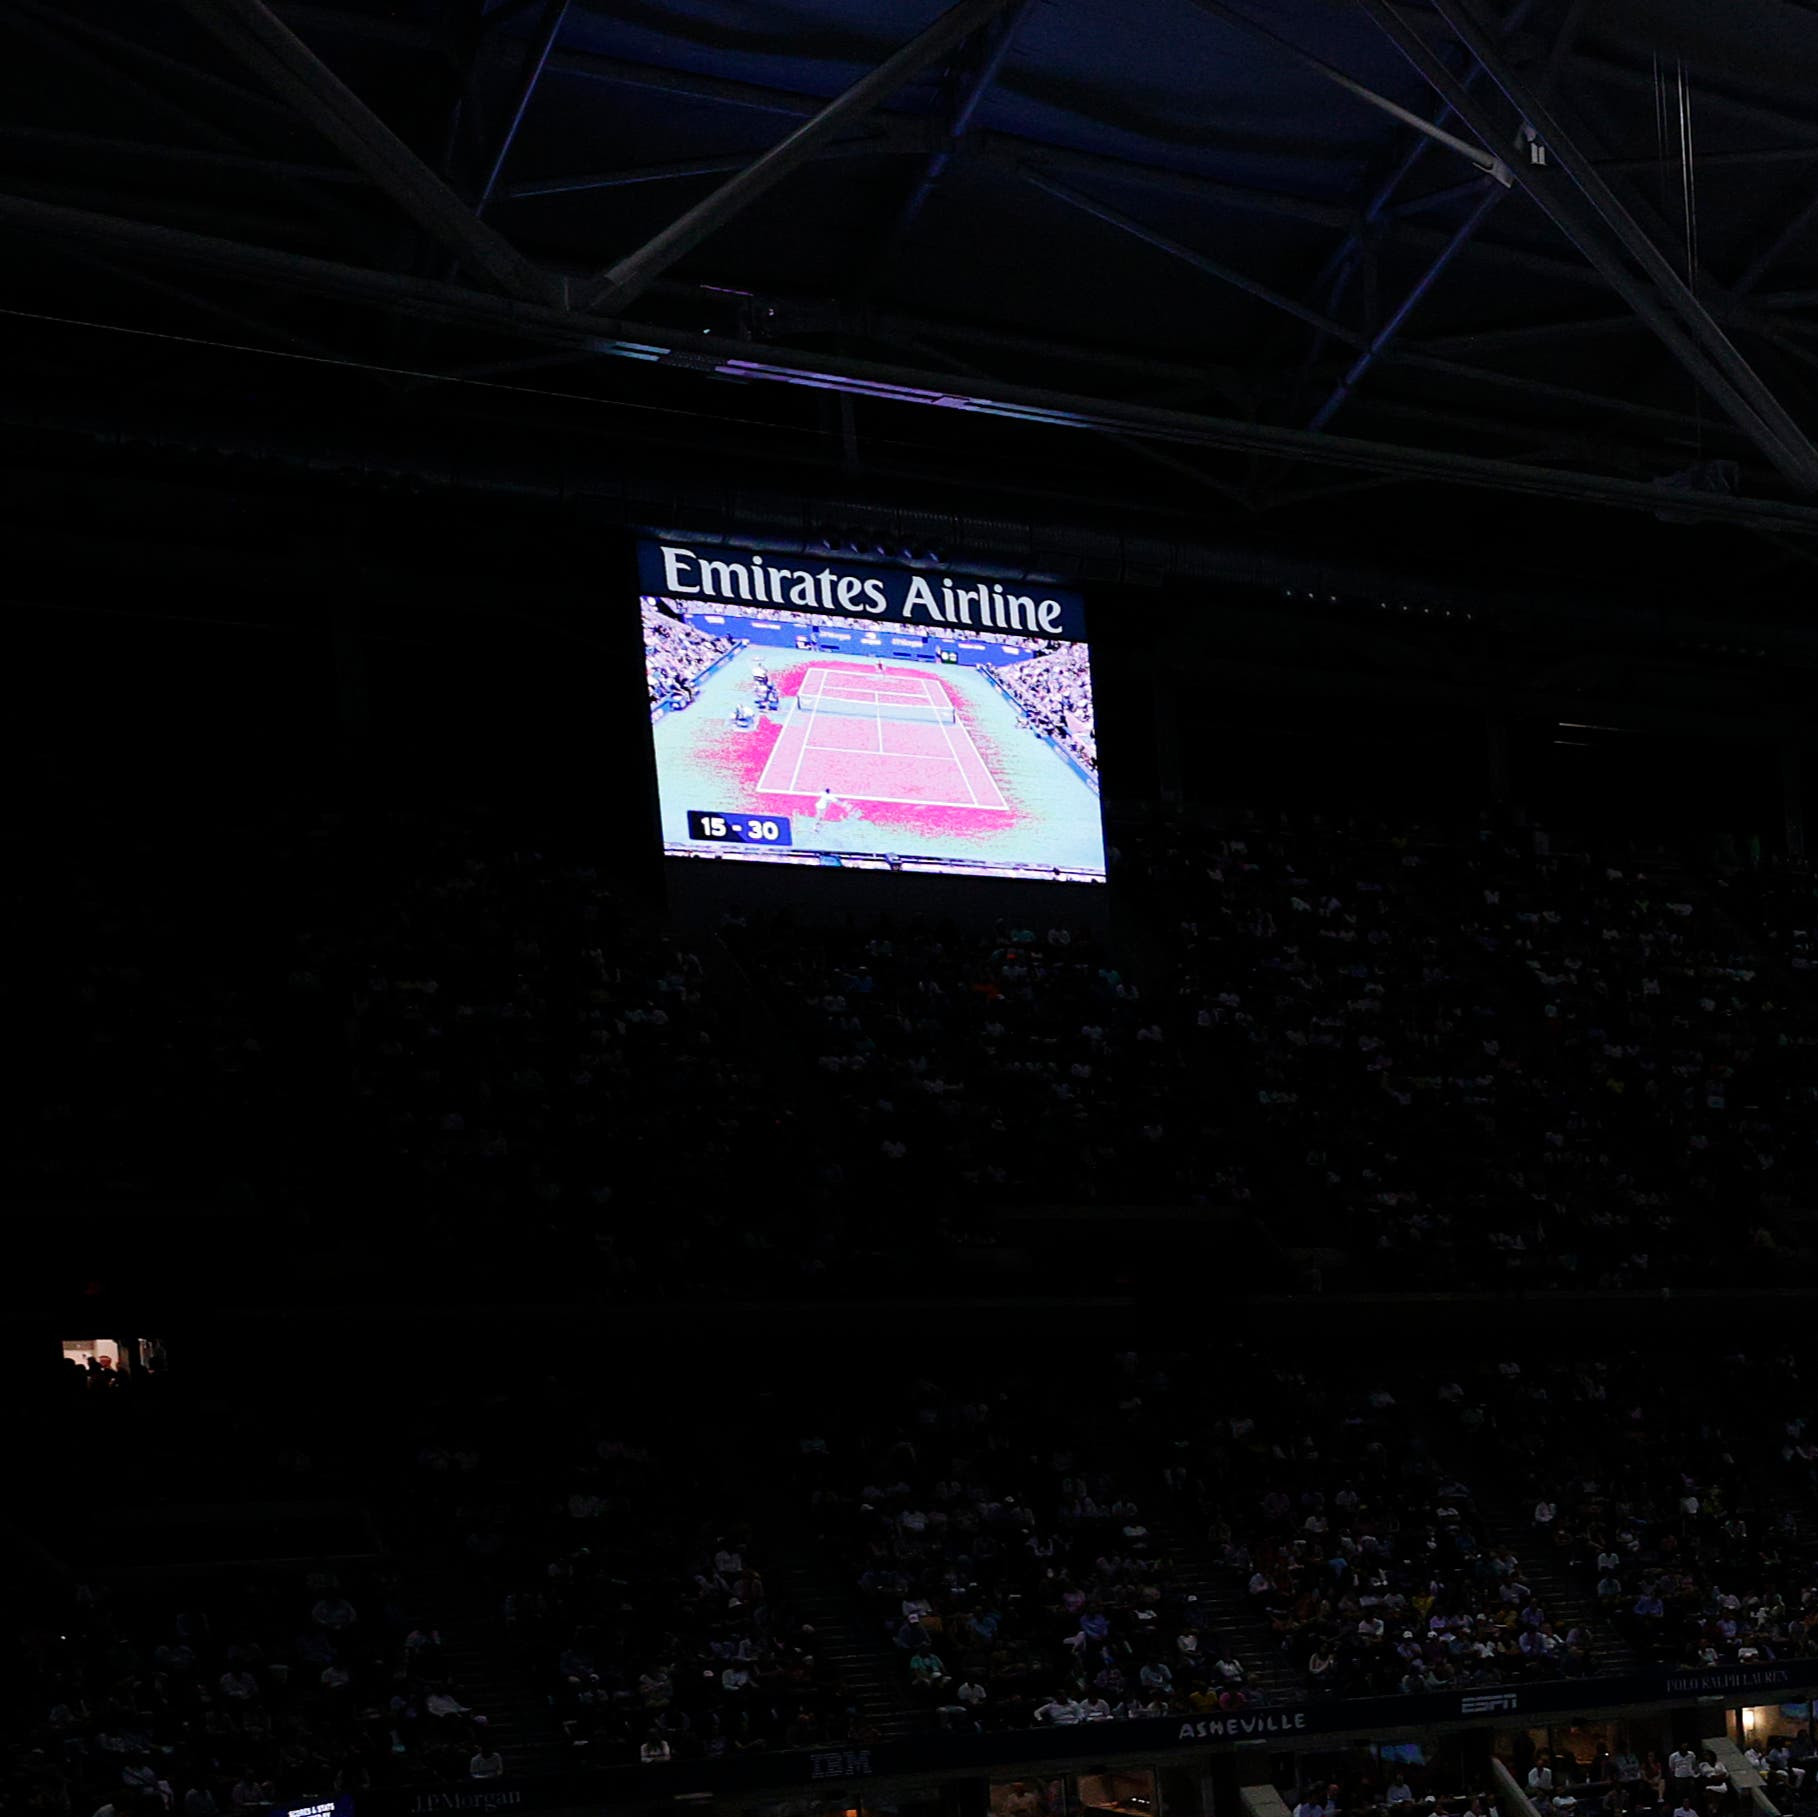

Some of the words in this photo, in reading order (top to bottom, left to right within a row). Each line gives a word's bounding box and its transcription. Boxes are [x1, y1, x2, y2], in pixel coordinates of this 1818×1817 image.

[659, 545, 888, 614] Emirates
[902, 575, 1064, 634] Airline
[700, 815, 728, 838] 15
[746, 816, 780, 841] 30
[1460, 1692, 1519, 1715] ESPN
[808, 1750, 872, 1781] IBM
